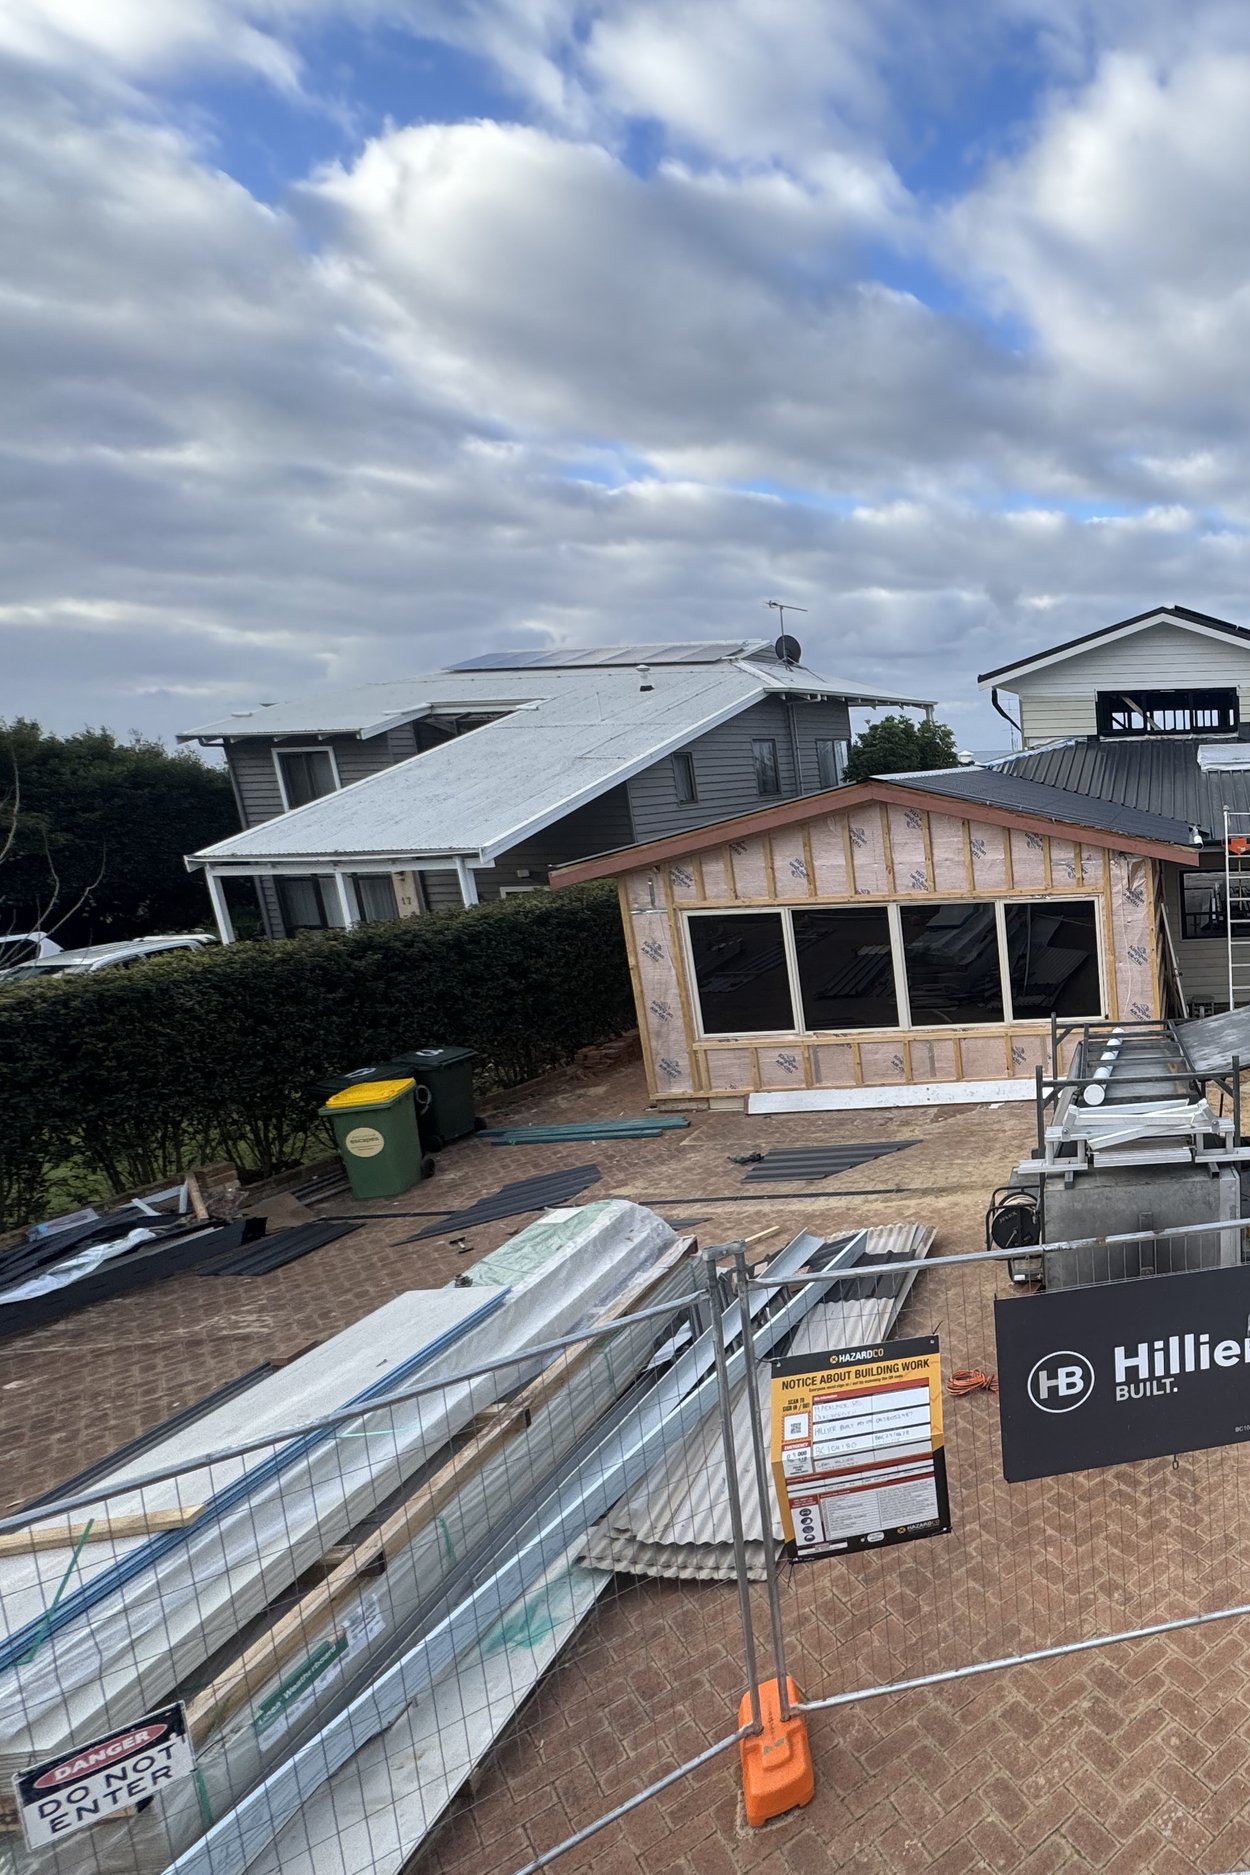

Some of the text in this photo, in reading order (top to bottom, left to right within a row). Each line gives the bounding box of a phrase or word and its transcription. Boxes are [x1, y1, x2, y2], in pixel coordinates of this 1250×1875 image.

[1127, 944, 1149, 962] Kingspan
[1131, 1001, 1152, 1019] Kingspan
[776, 1052, 799, 1071] Kingspan
[839, 1348, 884, 1363] HAZARDCO
[781, 1358, 930, 1391] NOTICE ABOUT BUILDING WORK
[1039, 1365, 1084, 1400] HB
[1115, 1377, 1178, 1401] BUILT.
[54, 1730, 151, 1782] DANGER
[38, 1742, 177, 1820] DO NOT
[49, 1765, 173, 1833] ENTER
